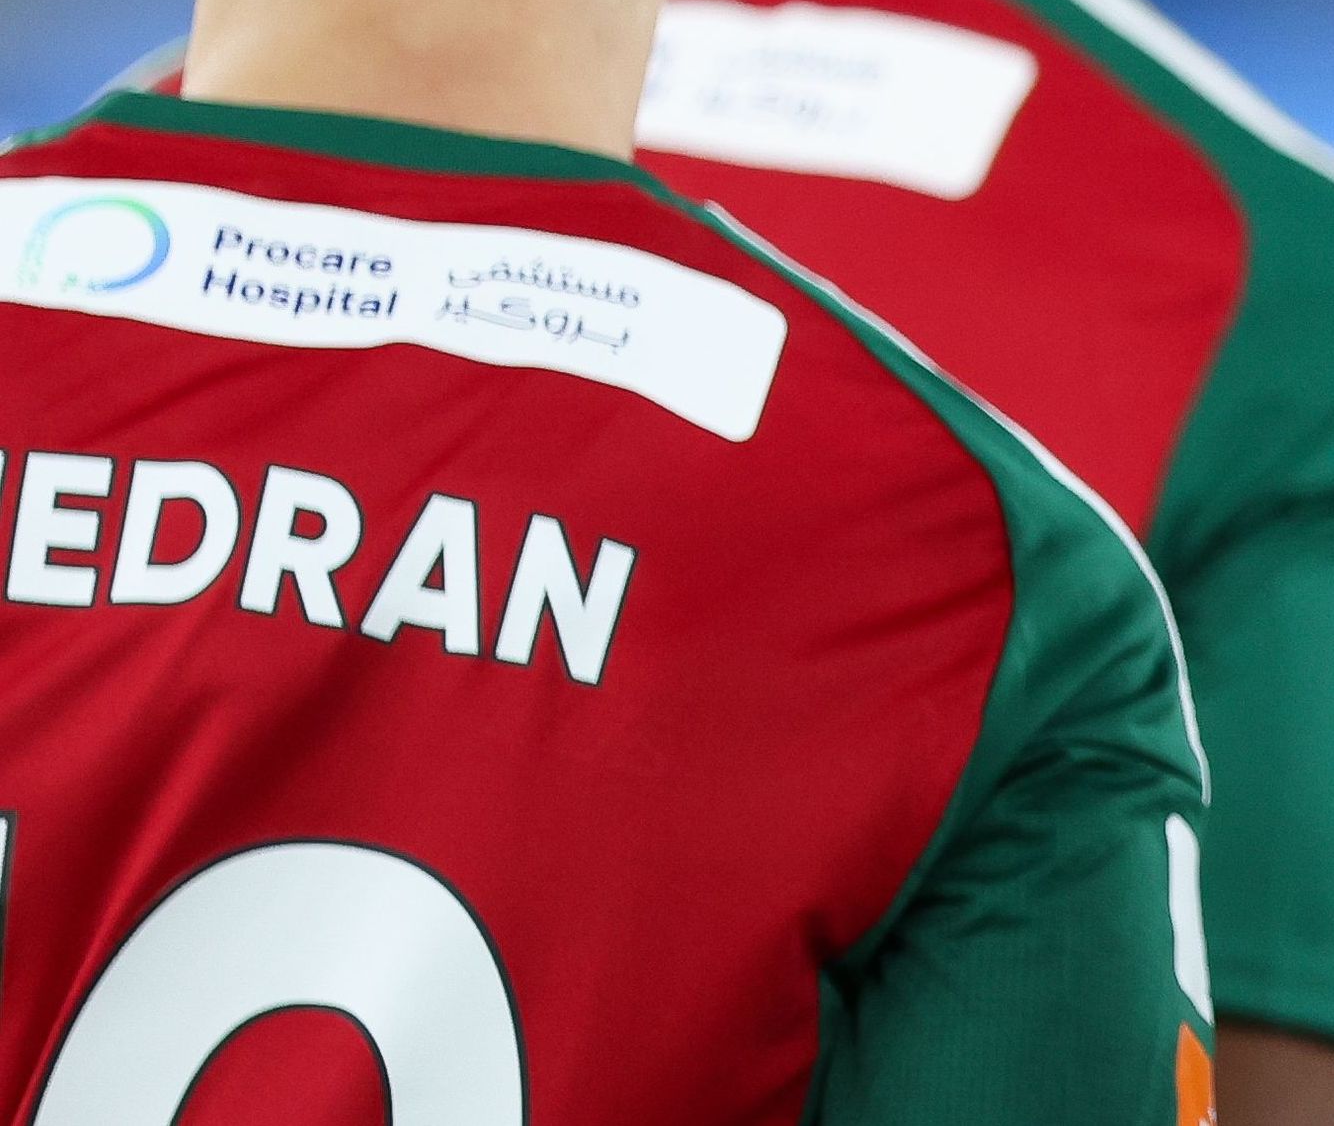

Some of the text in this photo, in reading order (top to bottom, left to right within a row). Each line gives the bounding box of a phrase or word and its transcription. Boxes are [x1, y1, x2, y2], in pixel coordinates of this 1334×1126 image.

[212, 225, 393, 278] Procare
[202, 267, 398, 320] Hospital
[0, 448, 638, 686] EDRAN
